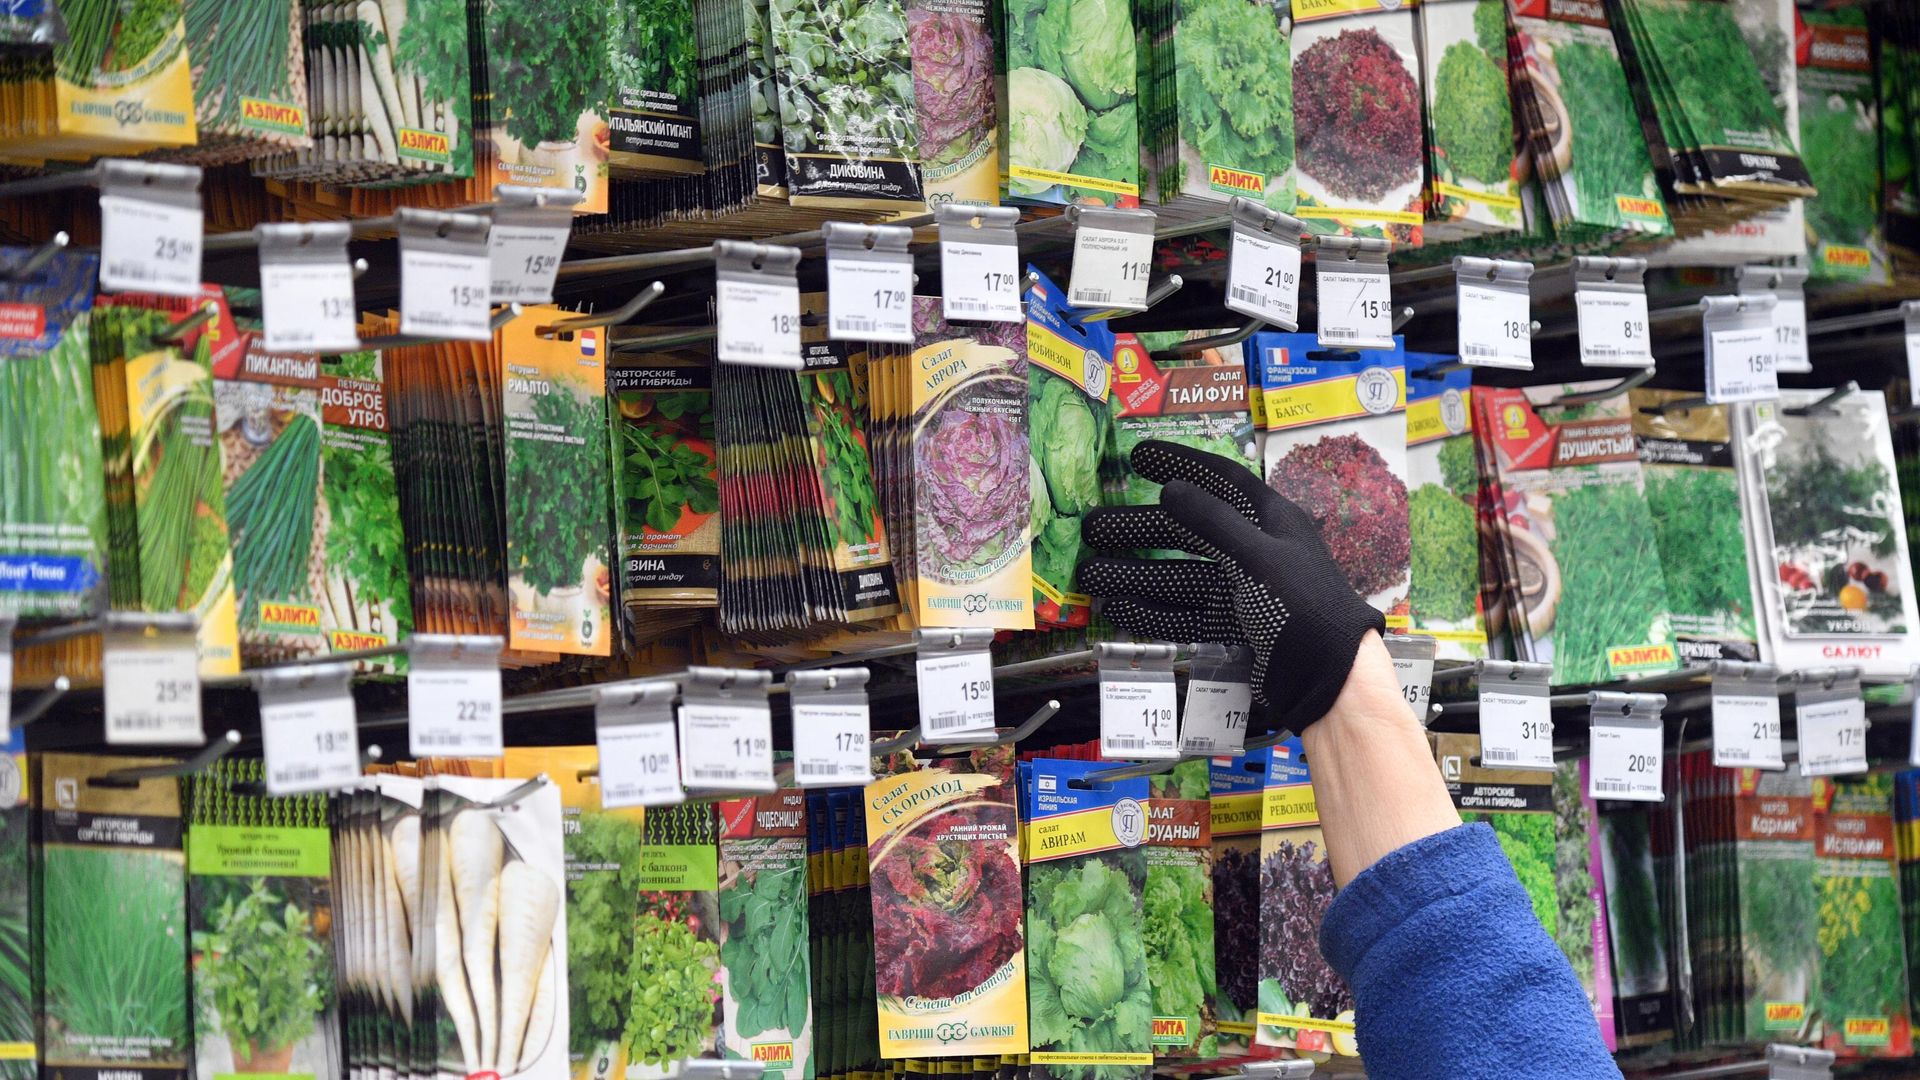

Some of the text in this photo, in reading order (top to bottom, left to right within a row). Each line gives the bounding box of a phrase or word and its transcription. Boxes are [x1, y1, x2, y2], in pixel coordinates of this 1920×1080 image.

[245, 100, 302, 126] АЭЛИТА
[608, 117, 693, 139] ИТАЛЬЯНСКИЙ ГИГАНТ
[401, 130, 447, 154] АЭЛИТА
[943, 139, 991, 175] от автора
[829, 164, 885, 180] ДИКОВИНА
[1212, 168, 1263, 192] АЭЛИТА
[1620, 199, 1663, 218] АЭЛИТА
[525, 255, 544, 274] 15
[1122, 262, 1138, 281] 11
[984, 272, 1014, 292] 17 00
[1265, 266, 1294, 287] 21 00
[873, 289, 892, 309] 17
[1361, 300, 1379, 319] 15
[771, 314, 790, 334] 18
[1504, 321, 1520, 339] 18
[1624, 321, 1632, 339] 8
[1776, 326, 1791, 345] 17
[921, 348, 953, 371] Салат
[1028, 339, 1072, 370] РОБИНЗОН
[245, 354, 318, 380] ПИКАНТНЫЙ
[1266, 366, 1318, 376] ФРАНЦУЗСКАЯ
[1749, 356, 1764, 373] 15
[615, 370, 676, 378] АВТОРСКИЕ
[640, 378, 692, 386] ГИБРИДЫ
[924, 359, 967, 392] АВРОРА
[1213, 371, 1241, 381] САЛАТ
[1267, 374, 1293, 383] ЛИНИЯ
[337, 379, 382, 393] ПЕТРУШКА
[508, 378, 550, 396] РИАЛТО
[1169, 384, 1244, 404] ТАЙФУН
[321, 388, 383, 411] ДОБРОЕ
[349, 409, 385, 429] УТРО
[1275, 402, 1315, 419] БАКУС
[1558, 437, 1635, 461] ДУШИСТЫЙ
[647, 533, 681, 541] аромат
[631, 560, 665, 571] ВИНА
[940, 537, 1025, 580] Семена от автора
[658, 573, 684, 582] индау
[927, 597, 962, 609] ГАВРИШ
[988, 599, 1024, 612] GAVRISH
[264, 604, 317, 626] АЭЛИТА
[336, 633, 385, 651] АЭЛИТА
[1613, 648, 1672, 666] АЭЛИТА
[1822, 646, 1882, 658] САЛЮТ
[961, 680, 991, 702] 15 00
[1402, 685, 1418, 703] 15
[457, 701, 477, 721] 22
[1142, 708, 1172, 728] 11 00
[1225, 710, 1239, 729] 17
[1522, 722, 1549, 740] 31 00
[1753, 722, 1769, 740] 21
[1837, 729, 1852, 747] 17
[733, 738, 751, 757] 11
[835, 733, 864, 751] 17 00
[640, 754, 657, 774] 10
[1628, 754, 1657, 773] 20 00
[783, 795, 802, 806] ИНДАУ
[872, 782, 910, 811] Салат
[1038, 795, 1078, 804] ИЗРАИЛЬСКАЯ
[1473, 787, 1515, 797] АВТОРСКИЕ
[882, 779, 964, 825] СКОРОХОД
[1461, 796, 1484, 806] СОРТА
[1490, 797, 1527, 808] ГИБРИДЫ
[91, 818, 139, 831] АВТОРСКИЕ
[950, 823, 1007, 832] РАННИЙ УРОЖАЙ
[1039, 824, 1060, 834] салат
[77, 829, 102, 842] СОРТА
[113, 831, 154, 844] ГИБРИДЫ
[936, 833, 977, 842] ХРУСТЯЩИХ
[1040, 831, 1087, 850] АВИРАМ
[648, 861, 688, 873] балкона
[905, 961, 1016, 1010] Семена от автора
[888, 1028, 934, 1041] ГАВРИШ
[970, 1024, 1015, 1037] GAVRISH
[1152, 1021, 1184, 1036] ЛИТА
[753, 1045, 792, 1061] АЭЛИТА
